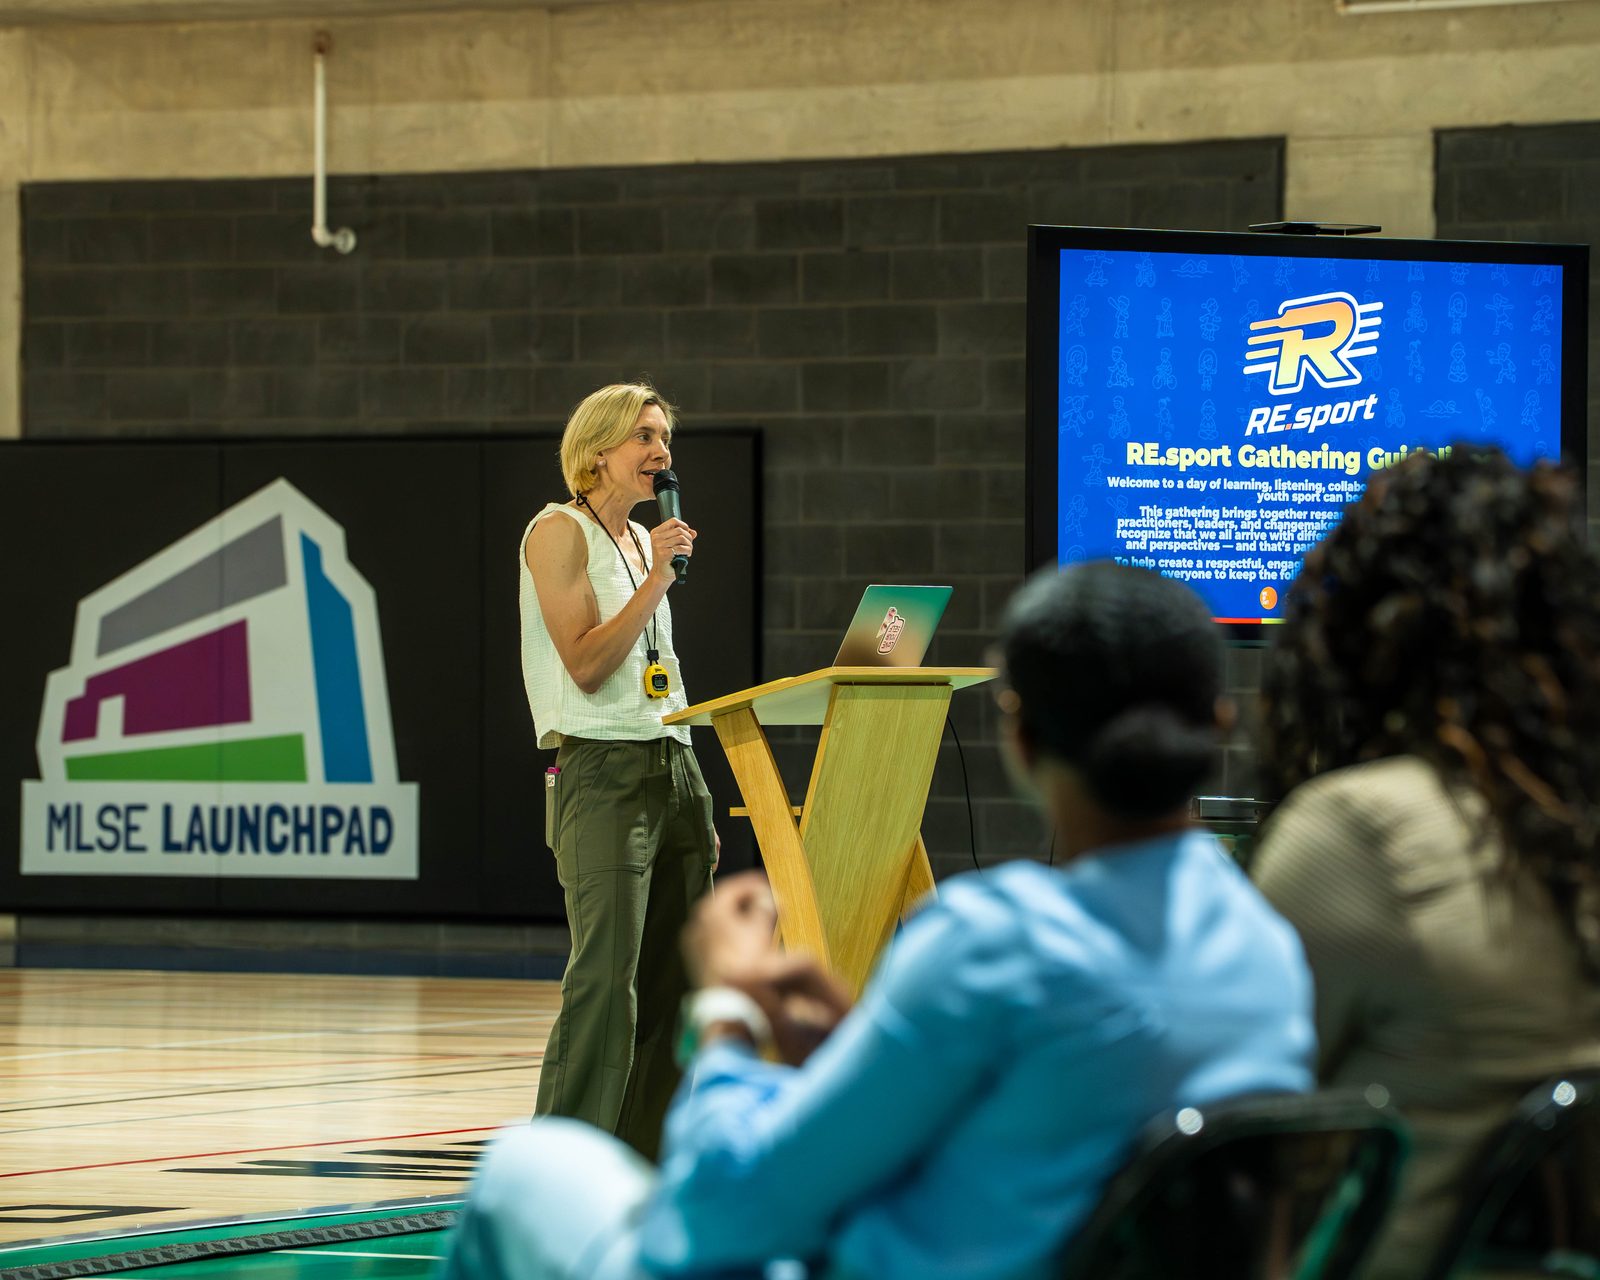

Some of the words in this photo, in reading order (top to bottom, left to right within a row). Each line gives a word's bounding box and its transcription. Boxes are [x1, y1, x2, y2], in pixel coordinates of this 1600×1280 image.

[1244, 394, 1379, 436] RE.sport
[1126, 442, 1232, 471] RE.sport
[1237, 443, 1361, 476] Gathering
[1107, 476, 1160, 489] Welcome
[1162, 478, 1174, 488] to
[1177, 479, 1184, 489] a
[1186, 477, 1208, 491] day
[1209, 478, 1222, 490] of
[1223, 478, 1272, 492] learning,
[1274, 479, 1326, 493] listening,
[1328, 480, 1367, 492] collabo
[1257, 491, 1289, 503] youth
[1291, 490, 1320, 504] sport
[1323, 493, 1343, 503] can
[1139, 505, 1163, 518] This
[1165, 505, 1220, 521] gathering
[1222, 506, 1257, 520] brings
[1259, 508, 1308, 521] together
[1310, 510, 1345, 520] resear
[1117, 516, 1192, 530] practitioners,
[1194, 518, 1238, 531] leaders,
[1240, 519, 1262, 530] and
[1264, 519, 1341, 532] changemake
[1116, 528, 1171, 541] recognize
[1173, 529, 1197, 539] that
[1200, 530, 1217, 540] we
[1219, 529, 1233, 540] all
[1235, 530, 1267, 541] arrive
[1269, 530, 1295, 541] with
[1297, 531, 1328, 541] differ
[1126, 539, 1147, 550] and
[1149, 539, 1221, 552] perspectives
[1236, 541, 1257, 551] and
[1115, 556, 1129, 567] To
[1131, 556, 1156, 569] help
[1158, 558, 1194, 568] create
[1196, 559, 1203, 568] a
[1205, 558, 1265, 571] respectful,
[1161, 568, 1213, 581] everyone
[1214, 569, 1227, 580] to
[1229, 569, 1257, 582] keep
[1259, 569, 1278, 580] the
[46, 803, 148, 852] MLSE
[162, 803, 394, 855] LAUNCHPAD
